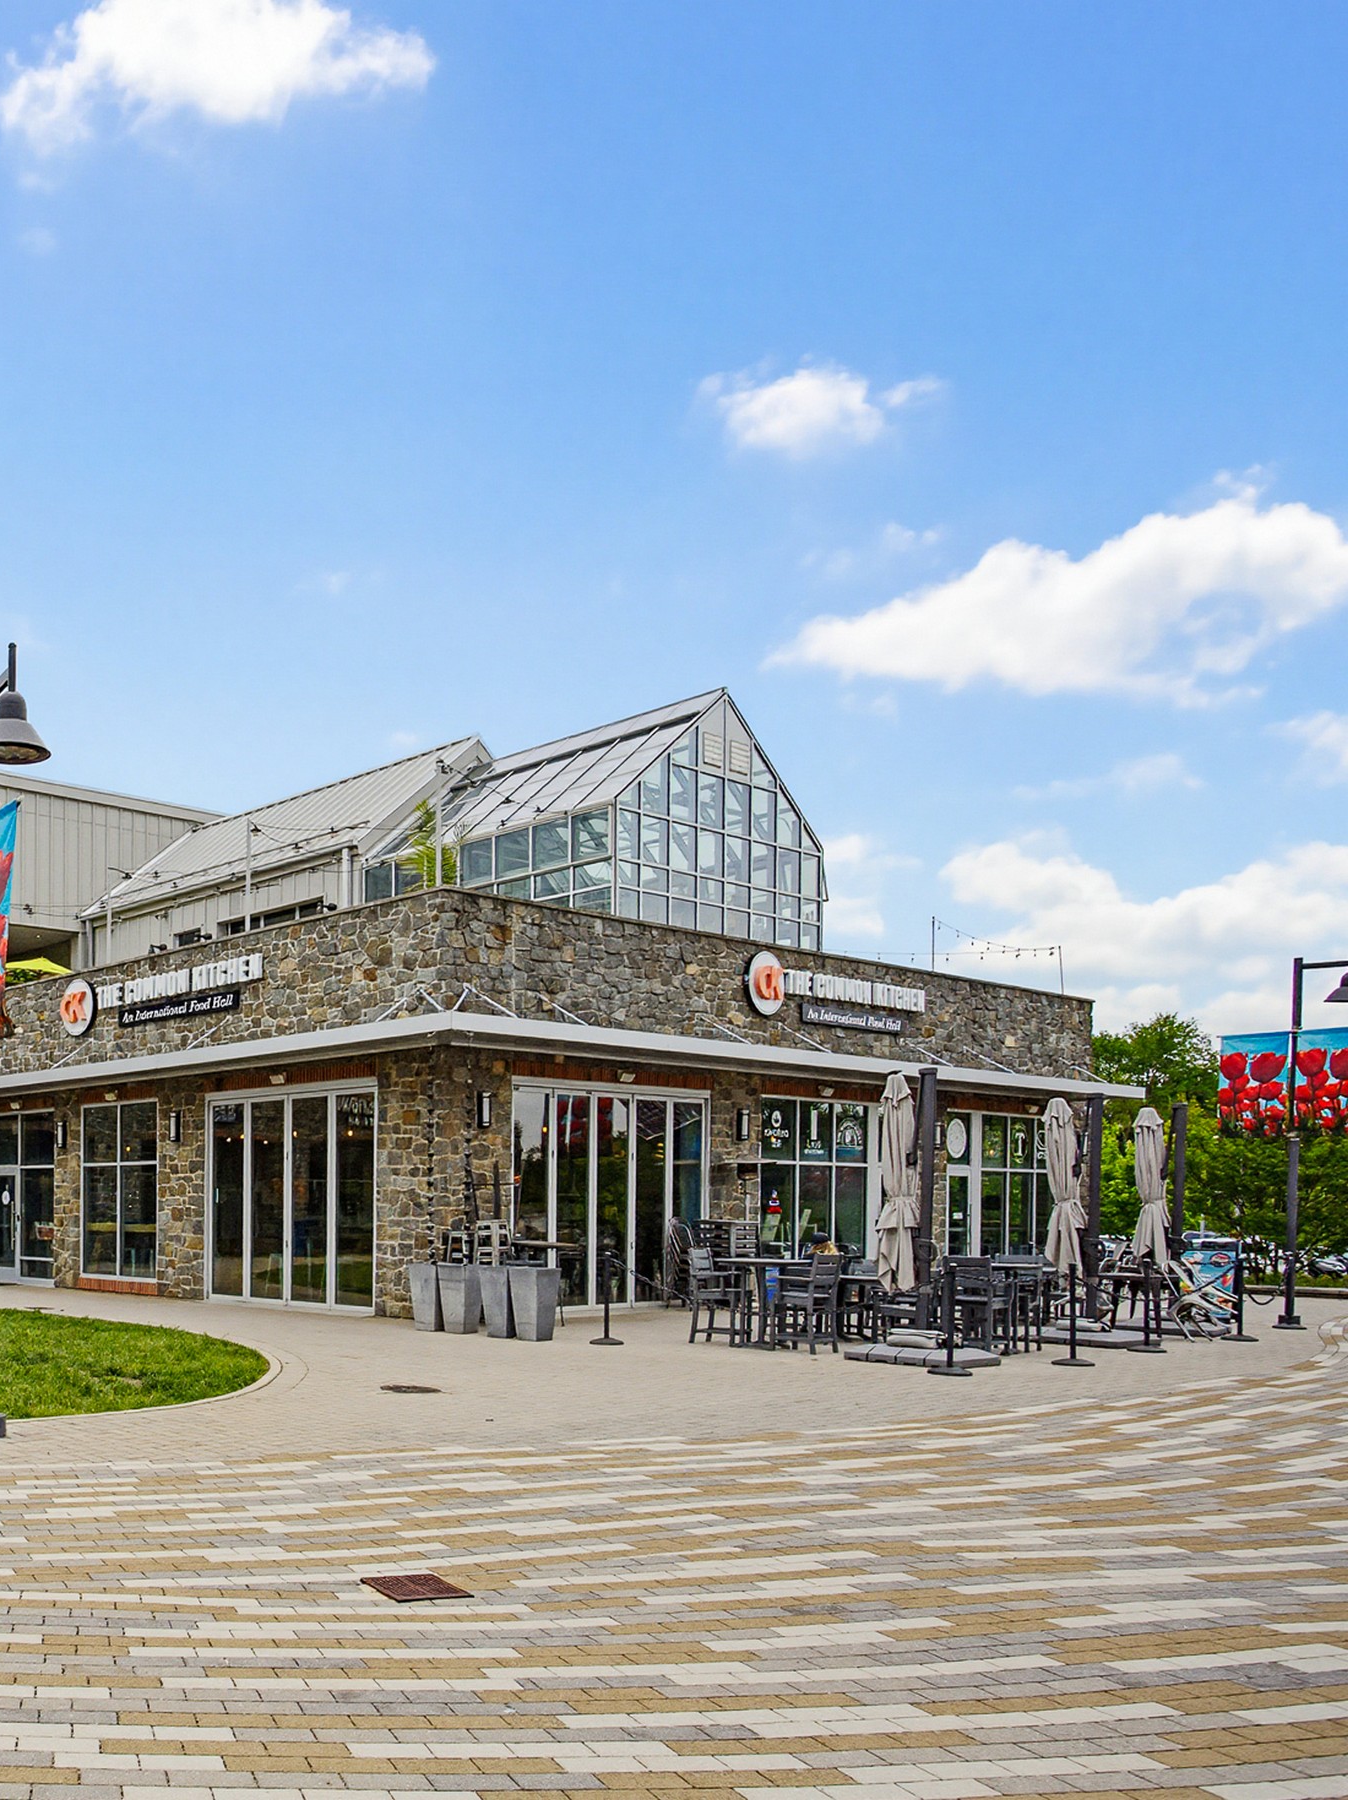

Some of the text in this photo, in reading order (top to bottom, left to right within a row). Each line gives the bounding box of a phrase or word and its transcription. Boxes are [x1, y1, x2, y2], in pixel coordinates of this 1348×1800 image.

[96, 953, 263, 1010] THE COMMON KITCHEN
[783, 969, 925, 1013] THE COMMON KITCHEN
[122, 994, 233, 1023] An International Food Hall
[820, 1010, 866, 1026] International
